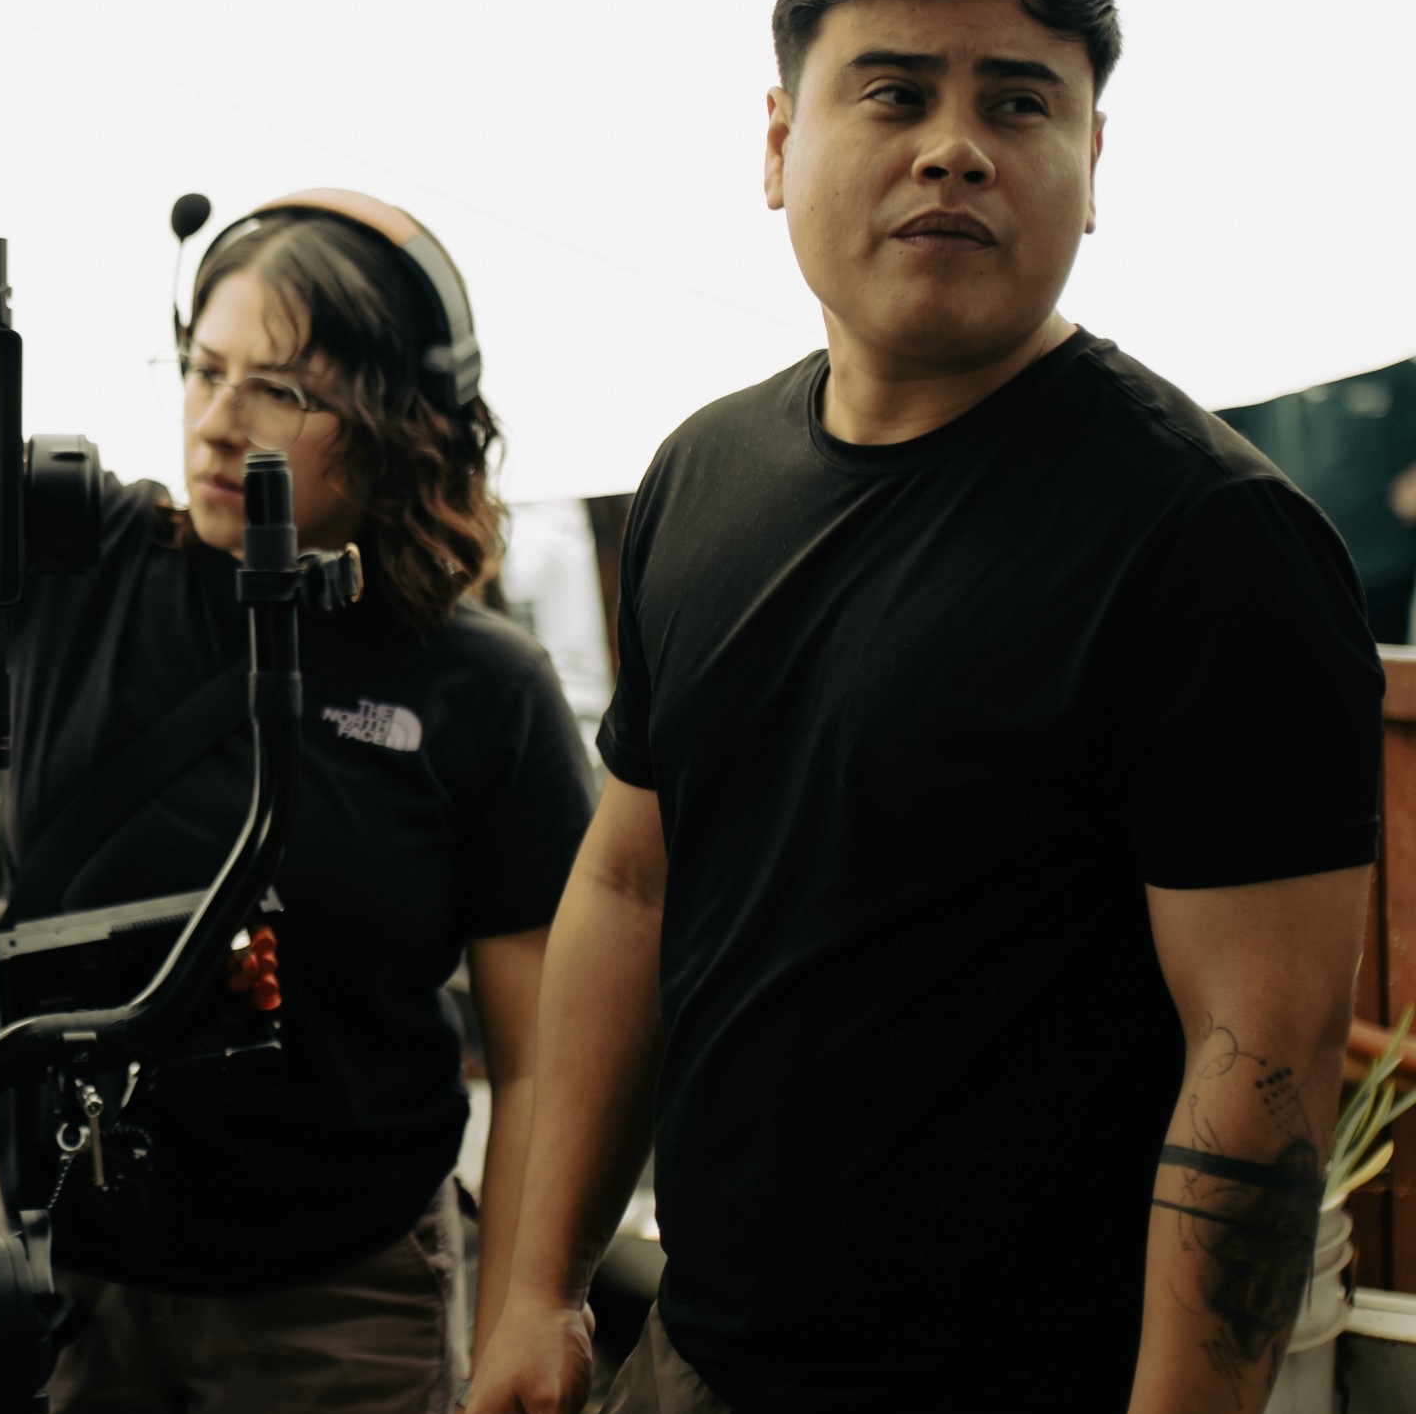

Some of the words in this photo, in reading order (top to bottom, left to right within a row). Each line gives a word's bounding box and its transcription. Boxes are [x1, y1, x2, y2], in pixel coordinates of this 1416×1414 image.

[321, 706, 392, 735] NORTH
[357, 699, 394, 720] THE
[337, 724, 386, 746] FACE
